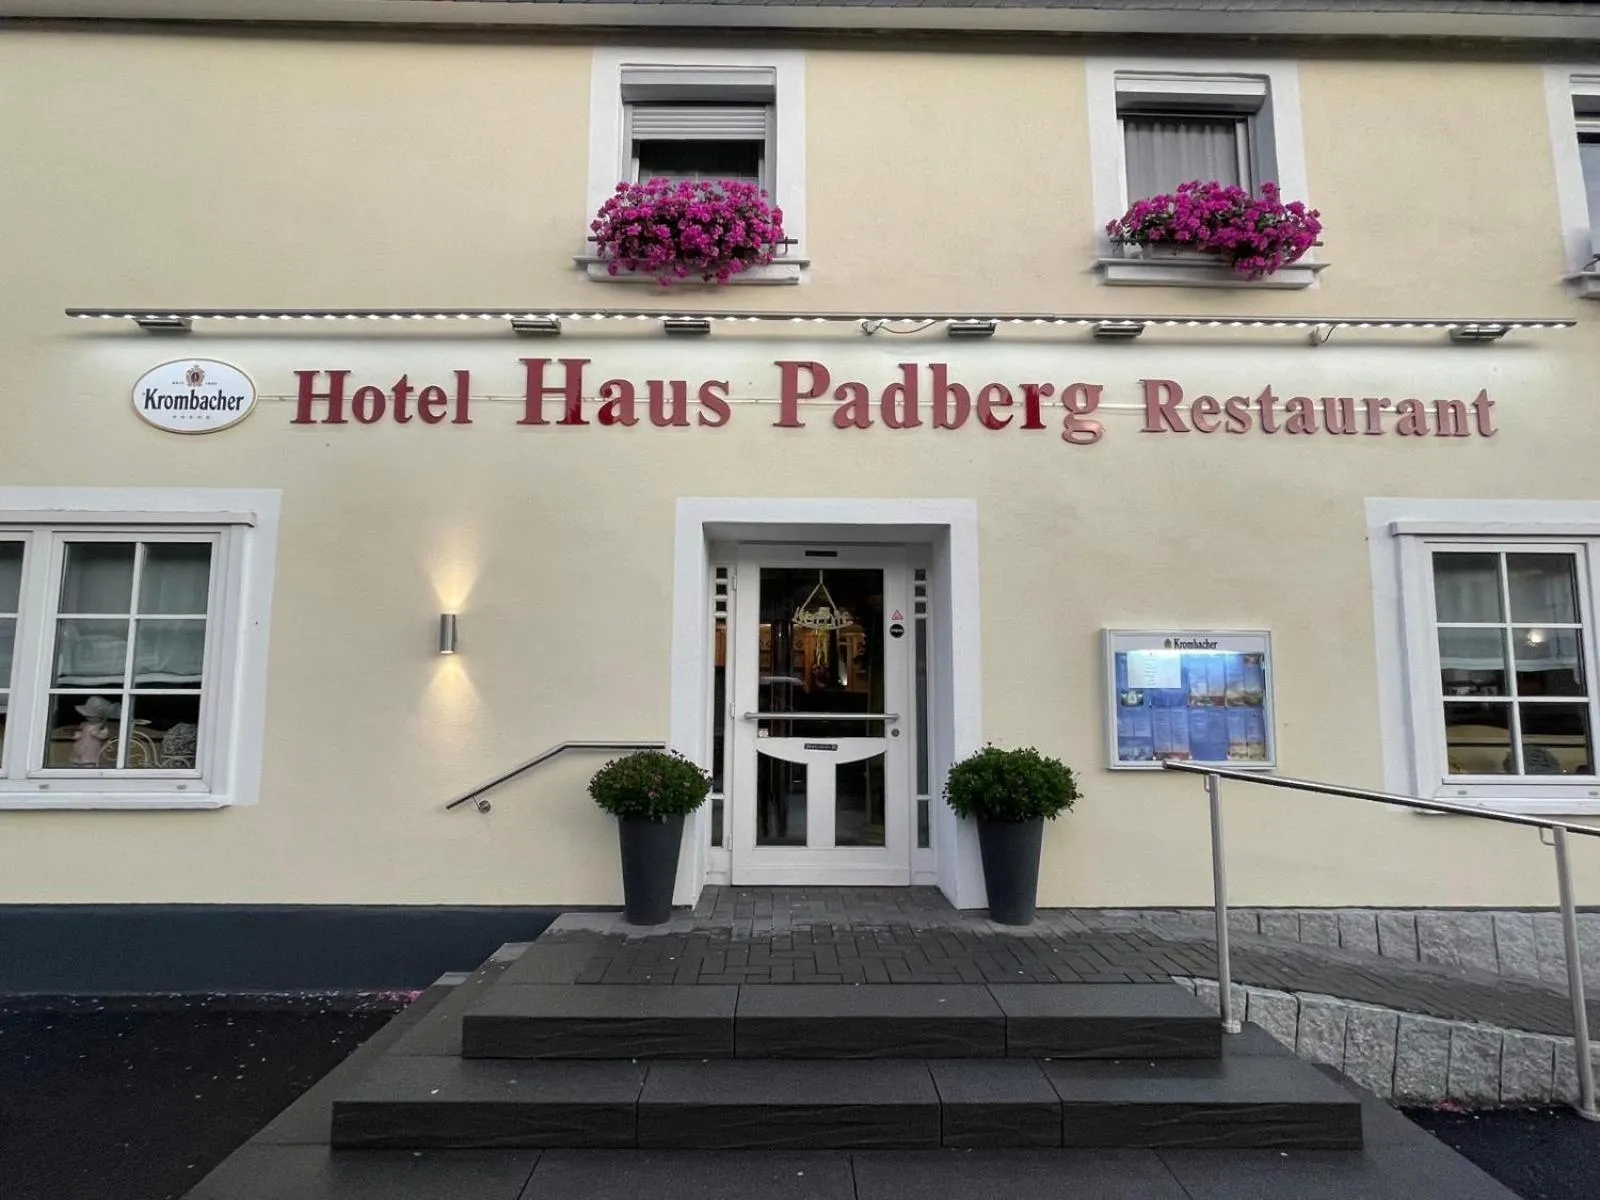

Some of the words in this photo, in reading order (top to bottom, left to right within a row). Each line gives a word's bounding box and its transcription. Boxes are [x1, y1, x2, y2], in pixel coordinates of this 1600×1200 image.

[144, 388, 244, 411] Krombacher
[290, 369, 473, 424] Hotel
[516, 357, 732, 428] Haus
[773, 360, 1104, 445] Padberg
[1138, 379, 1500, 437] Restaurant
[1173, 638, 1218, 649] Krombacher
